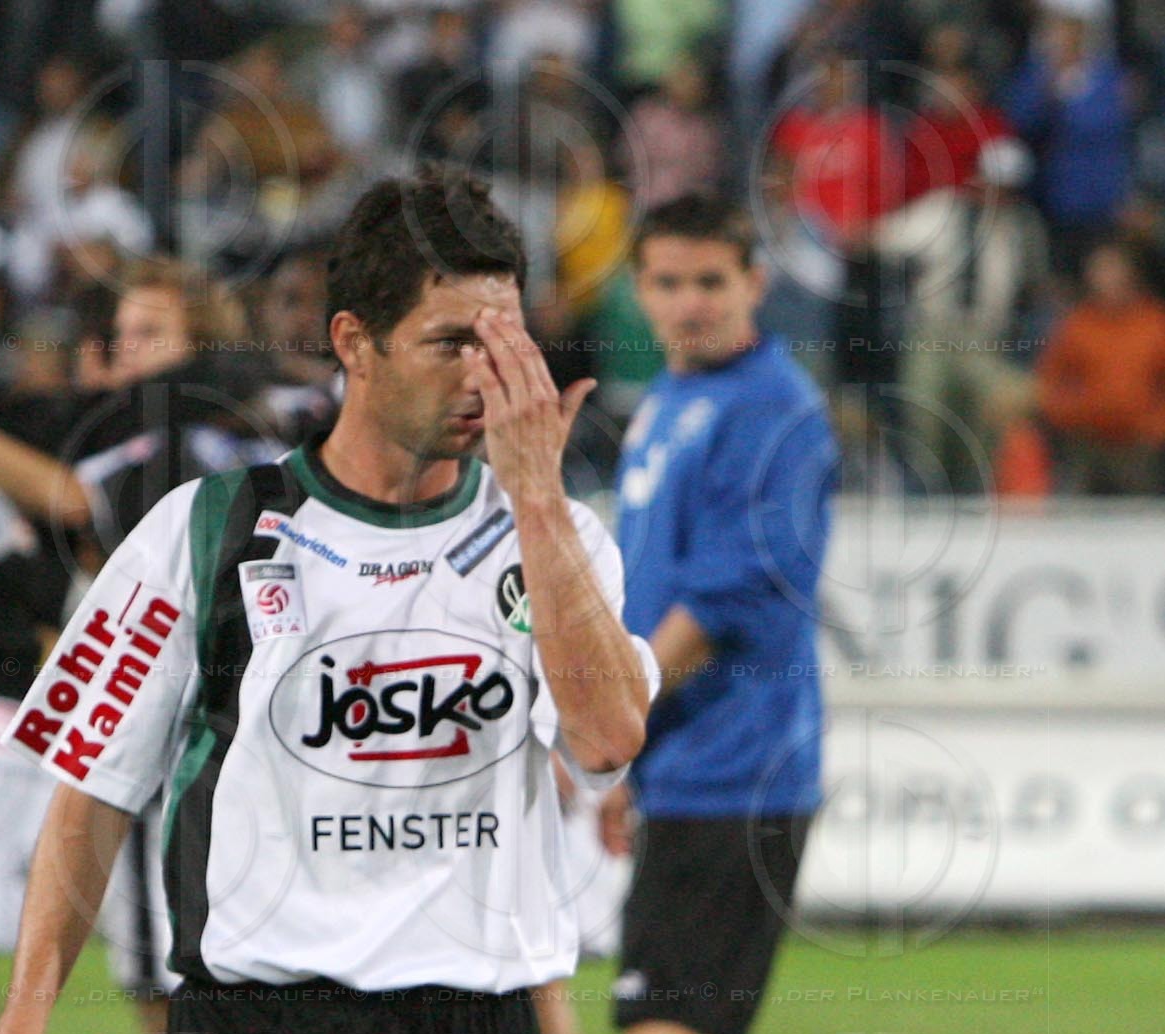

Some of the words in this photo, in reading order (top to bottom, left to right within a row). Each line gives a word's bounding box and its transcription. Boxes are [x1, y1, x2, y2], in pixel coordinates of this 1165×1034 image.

[358, 560, 434, 577] DRAGON
[14, 608, 116, 756] Rohr
[52, 596, 181, 782] Kamin
[301, 655, 514, 748] josko
[311, 812, 500, 852] FENSTER
